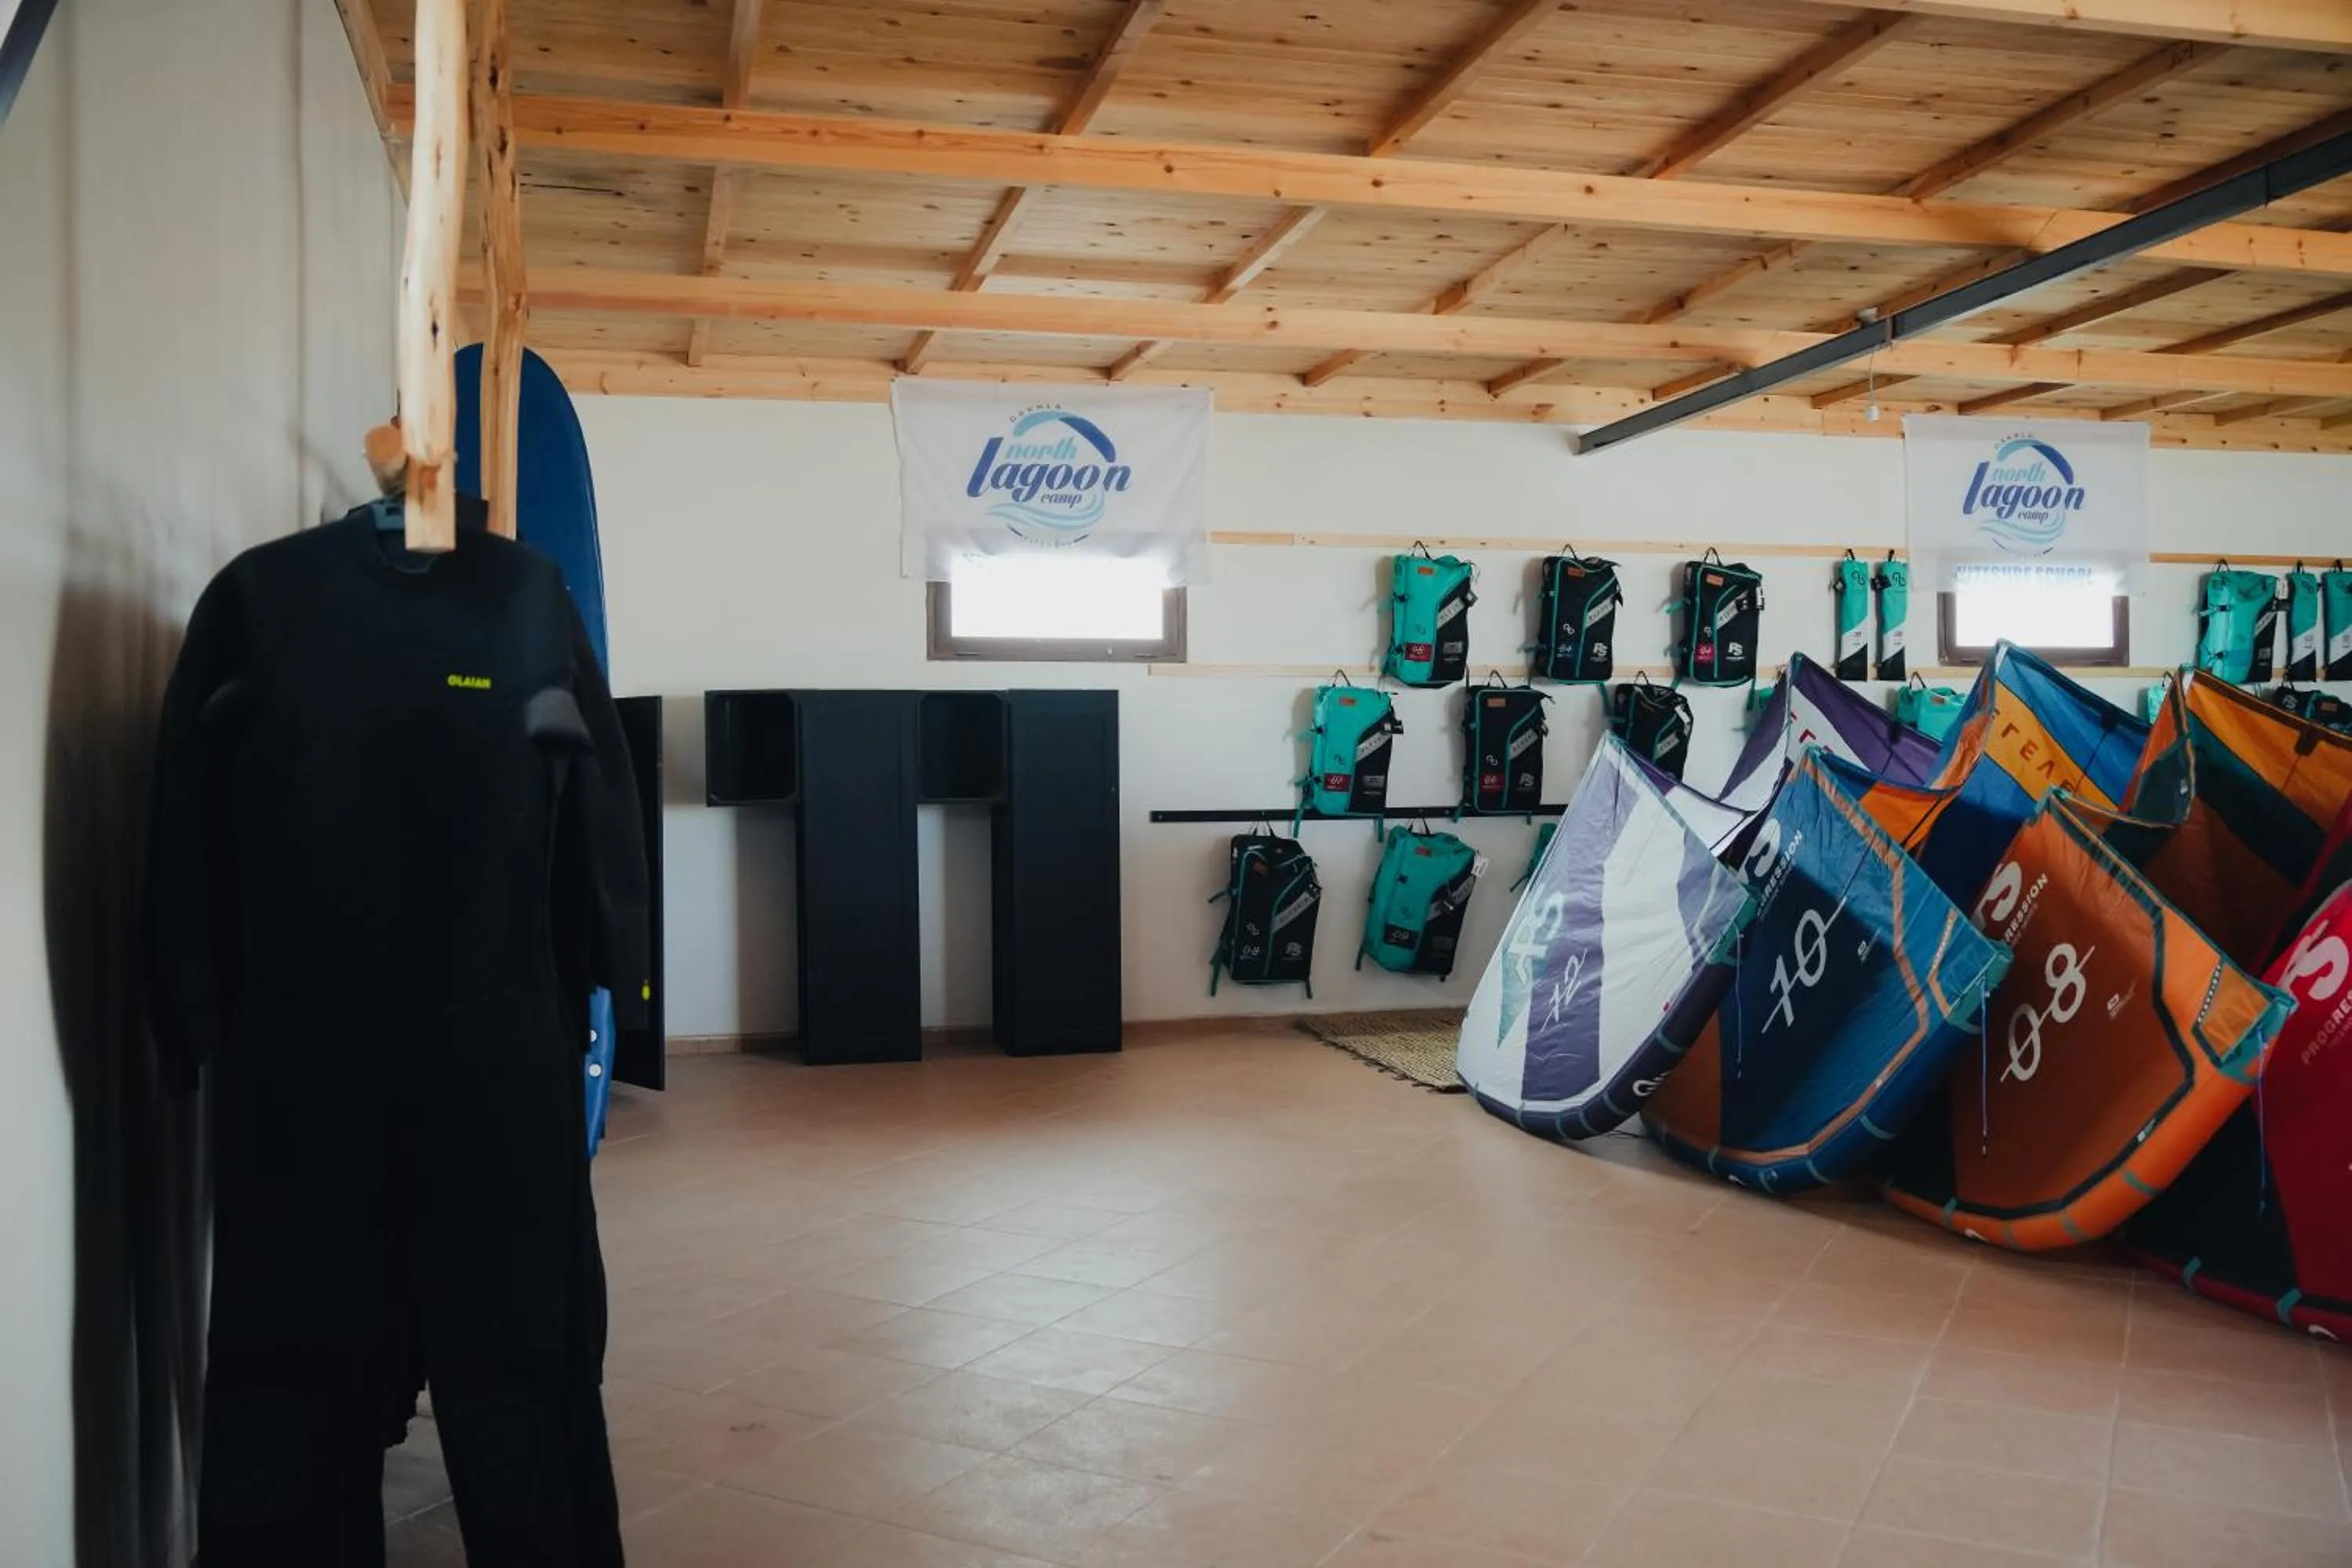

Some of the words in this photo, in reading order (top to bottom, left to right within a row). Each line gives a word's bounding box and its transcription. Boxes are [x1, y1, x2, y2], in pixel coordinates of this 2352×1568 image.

[967, 437, 1131, 503] lagoon
[1005, 437, 1078, 460] north
[1994, 461, 2045, 482] north
[1040, 492, 1082, 509] camp
[1962, 461, 2085, 519] lagoon
[2017, 511, 2049, 524] camp
[1759, 829, 1803, 911] RESSION
[2004, 873, 2049, 942] RESSION
[1764, 902, 1838, 1031] 10
[2004, 943, 2092, 1081] 08
